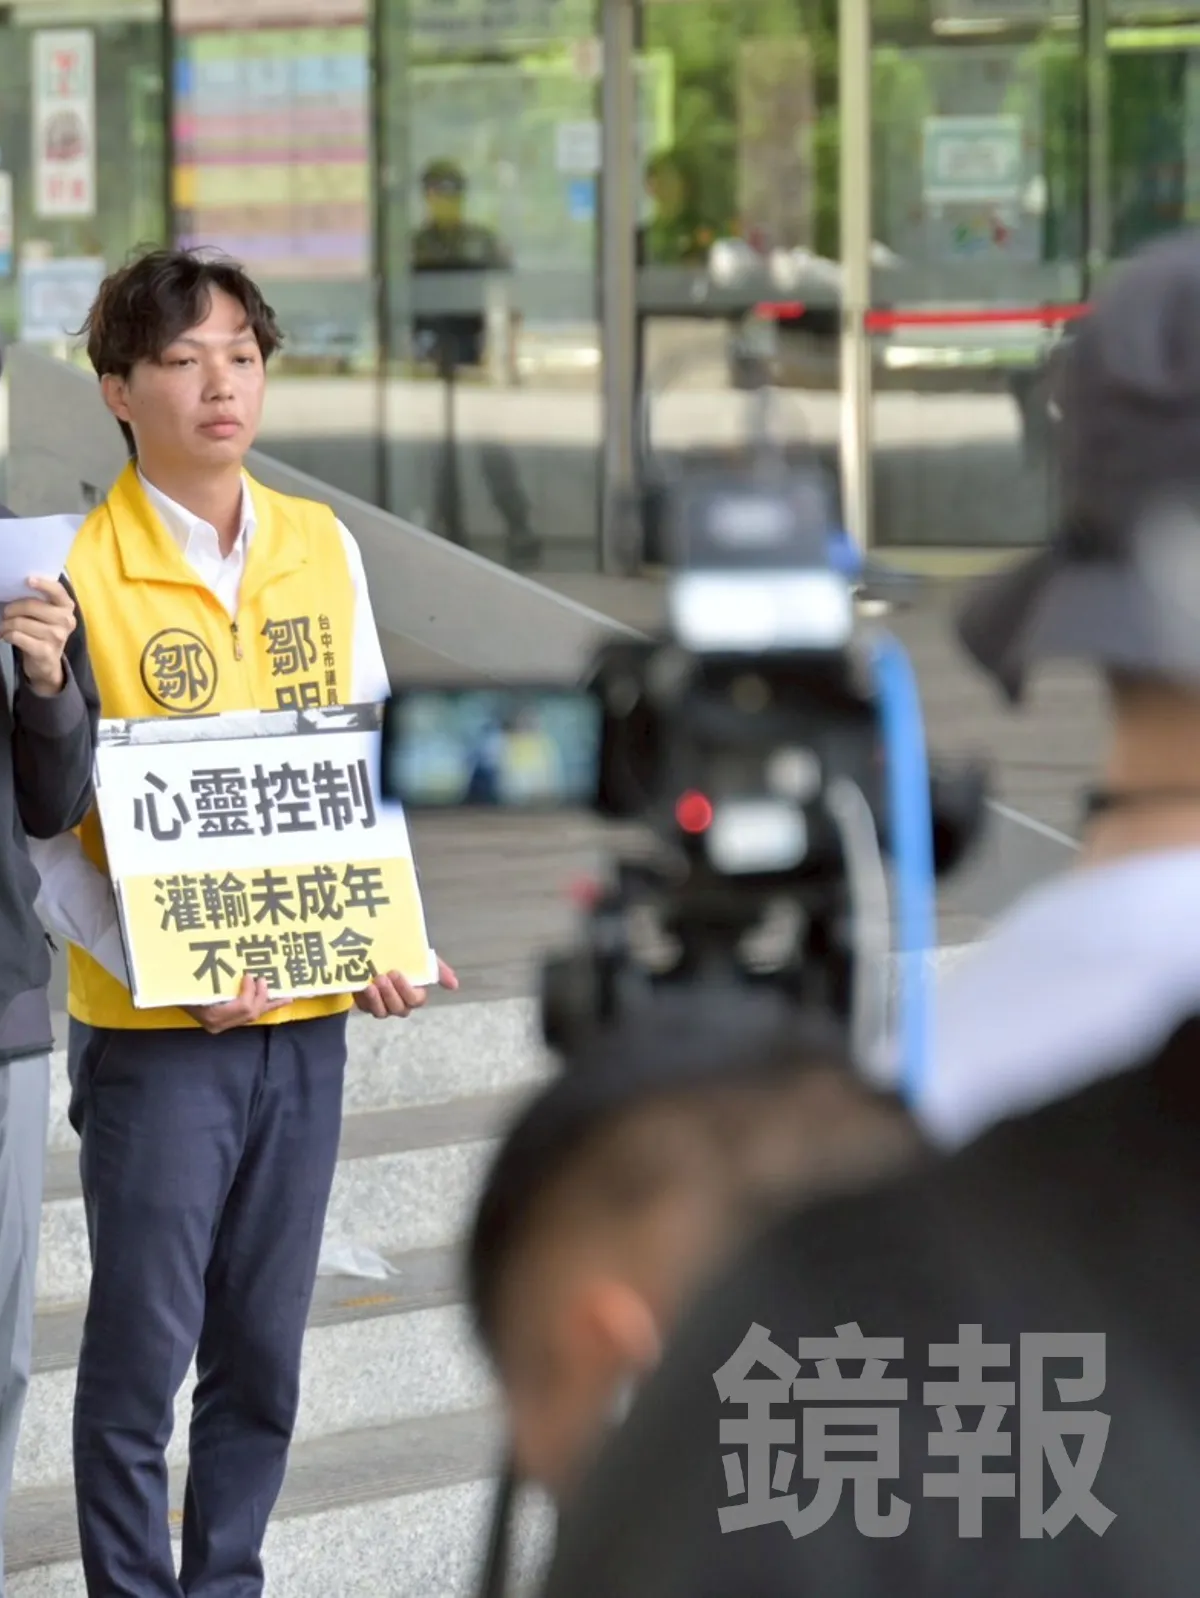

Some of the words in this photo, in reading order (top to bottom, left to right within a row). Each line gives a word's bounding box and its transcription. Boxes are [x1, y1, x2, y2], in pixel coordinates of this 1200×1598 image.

[150, 642, 209, 703] 鄒
[132, 758, 377, 841] 心靈控制
[153, 863, 391, 933] 灌輸未成年
[188, 927, 377, 995] 不當觀念
